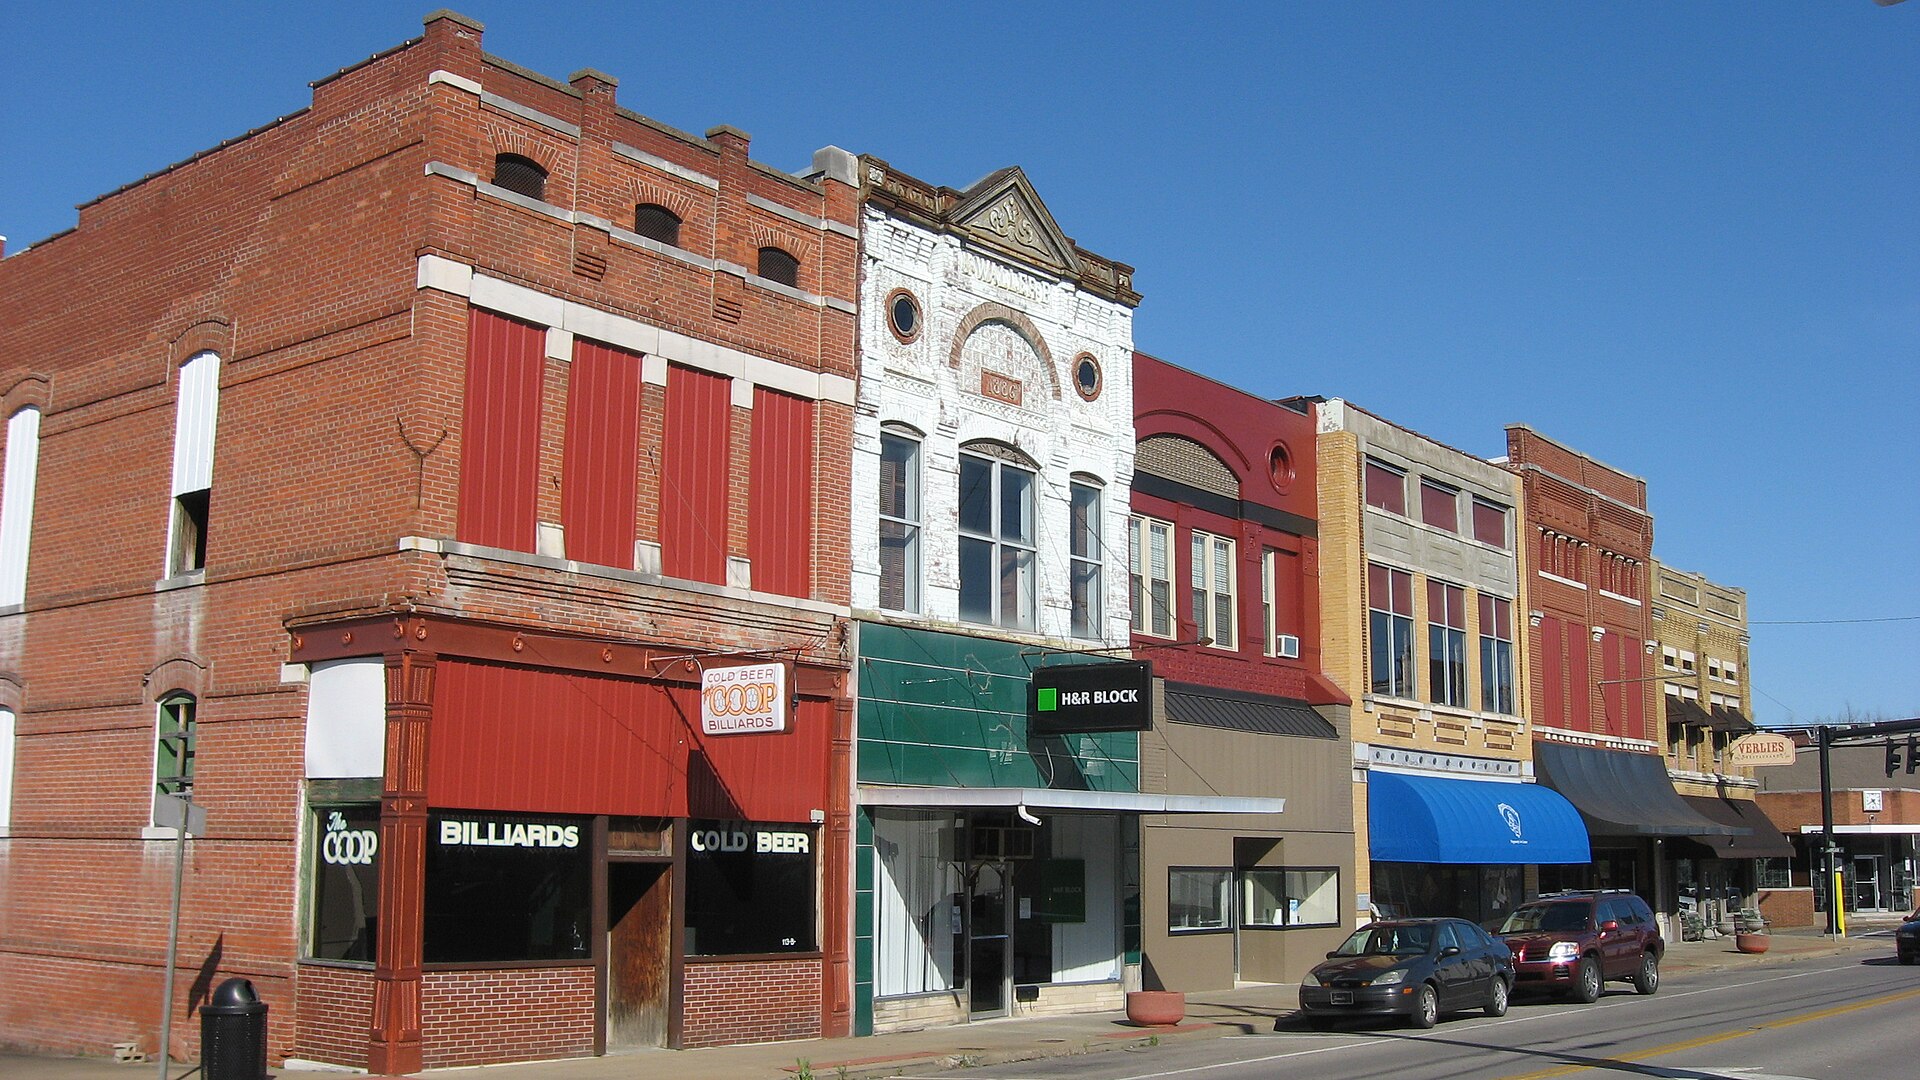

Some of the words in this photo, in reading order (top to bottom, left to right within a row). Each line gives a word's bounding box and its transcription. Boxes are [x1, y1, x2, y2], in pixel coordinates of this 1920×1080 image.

[707, 671, 735, 683] COLD
[740, 668, 774, 681] BEER
[709, 682, 777, 717] COOP
[1061, 691, 1091, 706] H&R
[1093, 689, 1138, 704] BLOCK
[708, 717, 774, 731] BILLIARDS
[1738, 741, 1785, 754] VERLIES
[326, 811, 347, 831] The
[440, 820, 579, 848] BILLIARDS
[691, 830, 748, 852] COLD
[756, 831, 809, 853] BEER
[323, 830, 378, 865] COOP
